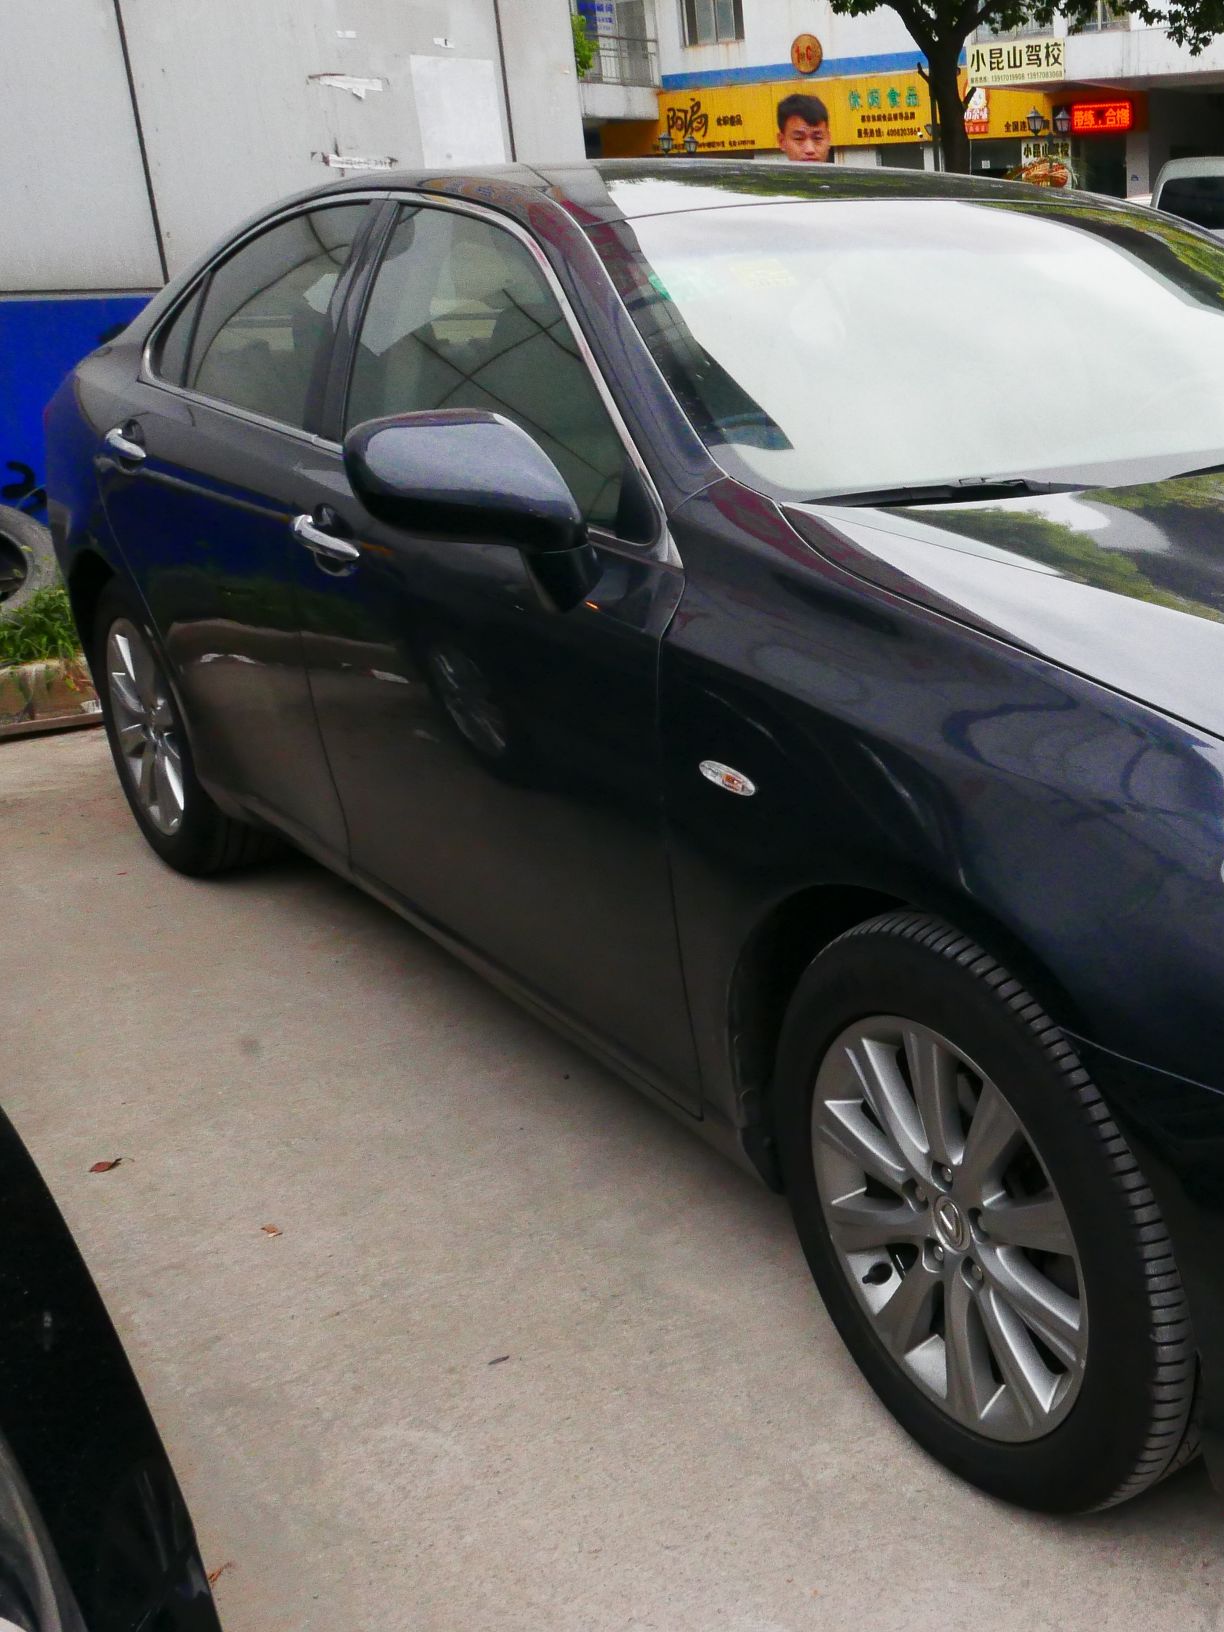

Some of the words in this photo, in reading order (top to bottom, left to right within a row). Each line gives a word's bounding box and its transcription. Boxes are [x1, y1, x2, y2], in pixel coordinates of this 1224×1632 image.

[970, 42, 1062, 72] 小昆山驾校
